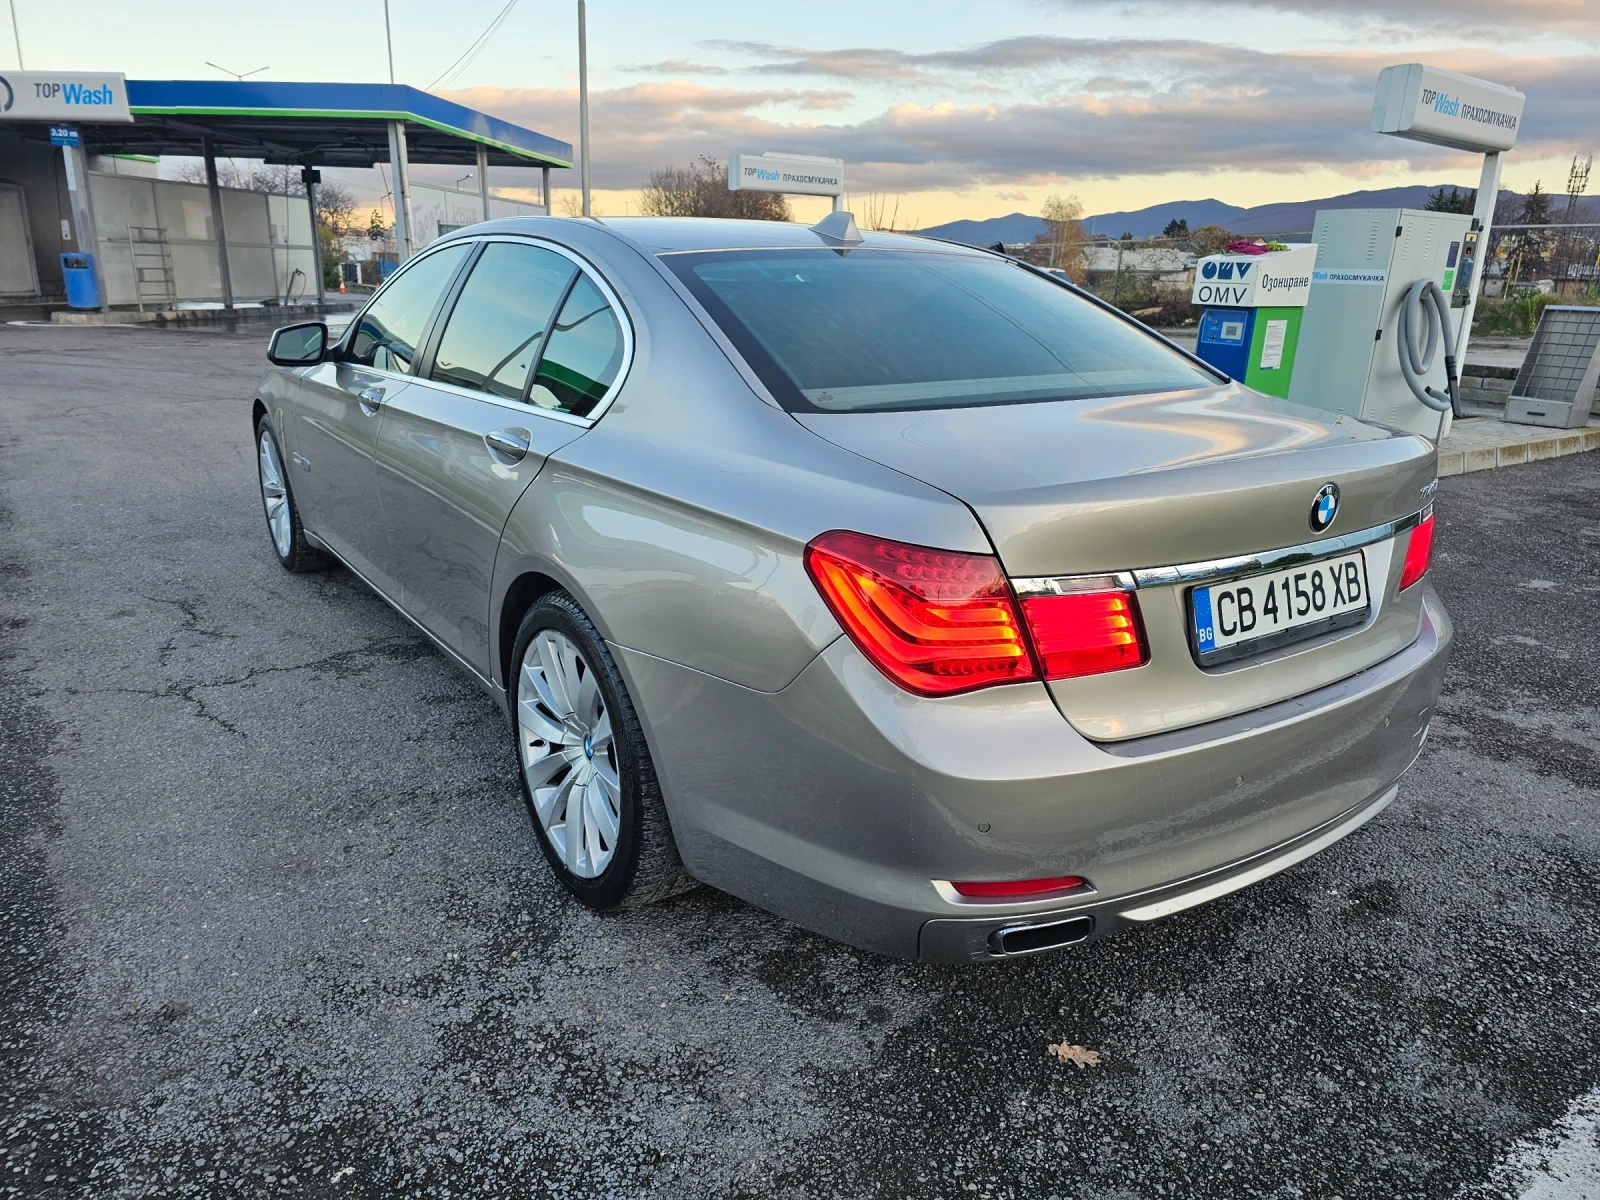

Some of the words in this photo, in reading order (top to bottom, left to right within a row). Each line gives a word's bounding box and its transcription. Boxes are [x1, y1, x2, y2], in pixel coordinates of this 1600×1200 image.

[1460, 104, 1517, 130] ПРАХОСМУКАЧКА
[50, 128, 68, 137] 3.20
[782, 173, 838, 186] ПРАХОСМУКАЧКА
[1262, 274, 1309, 292] Озониране
[1329, 273, 1384, 282] ПРАХОСМУКАЧКА
[1198, 285, 1247, 304] OMV
[1217, 586, 1257, 637] CB
[1263, 570, 1327, 625] 4158
[1329, 561, 1362, 609] XB
[1199, 626, 1213, 641] BG
